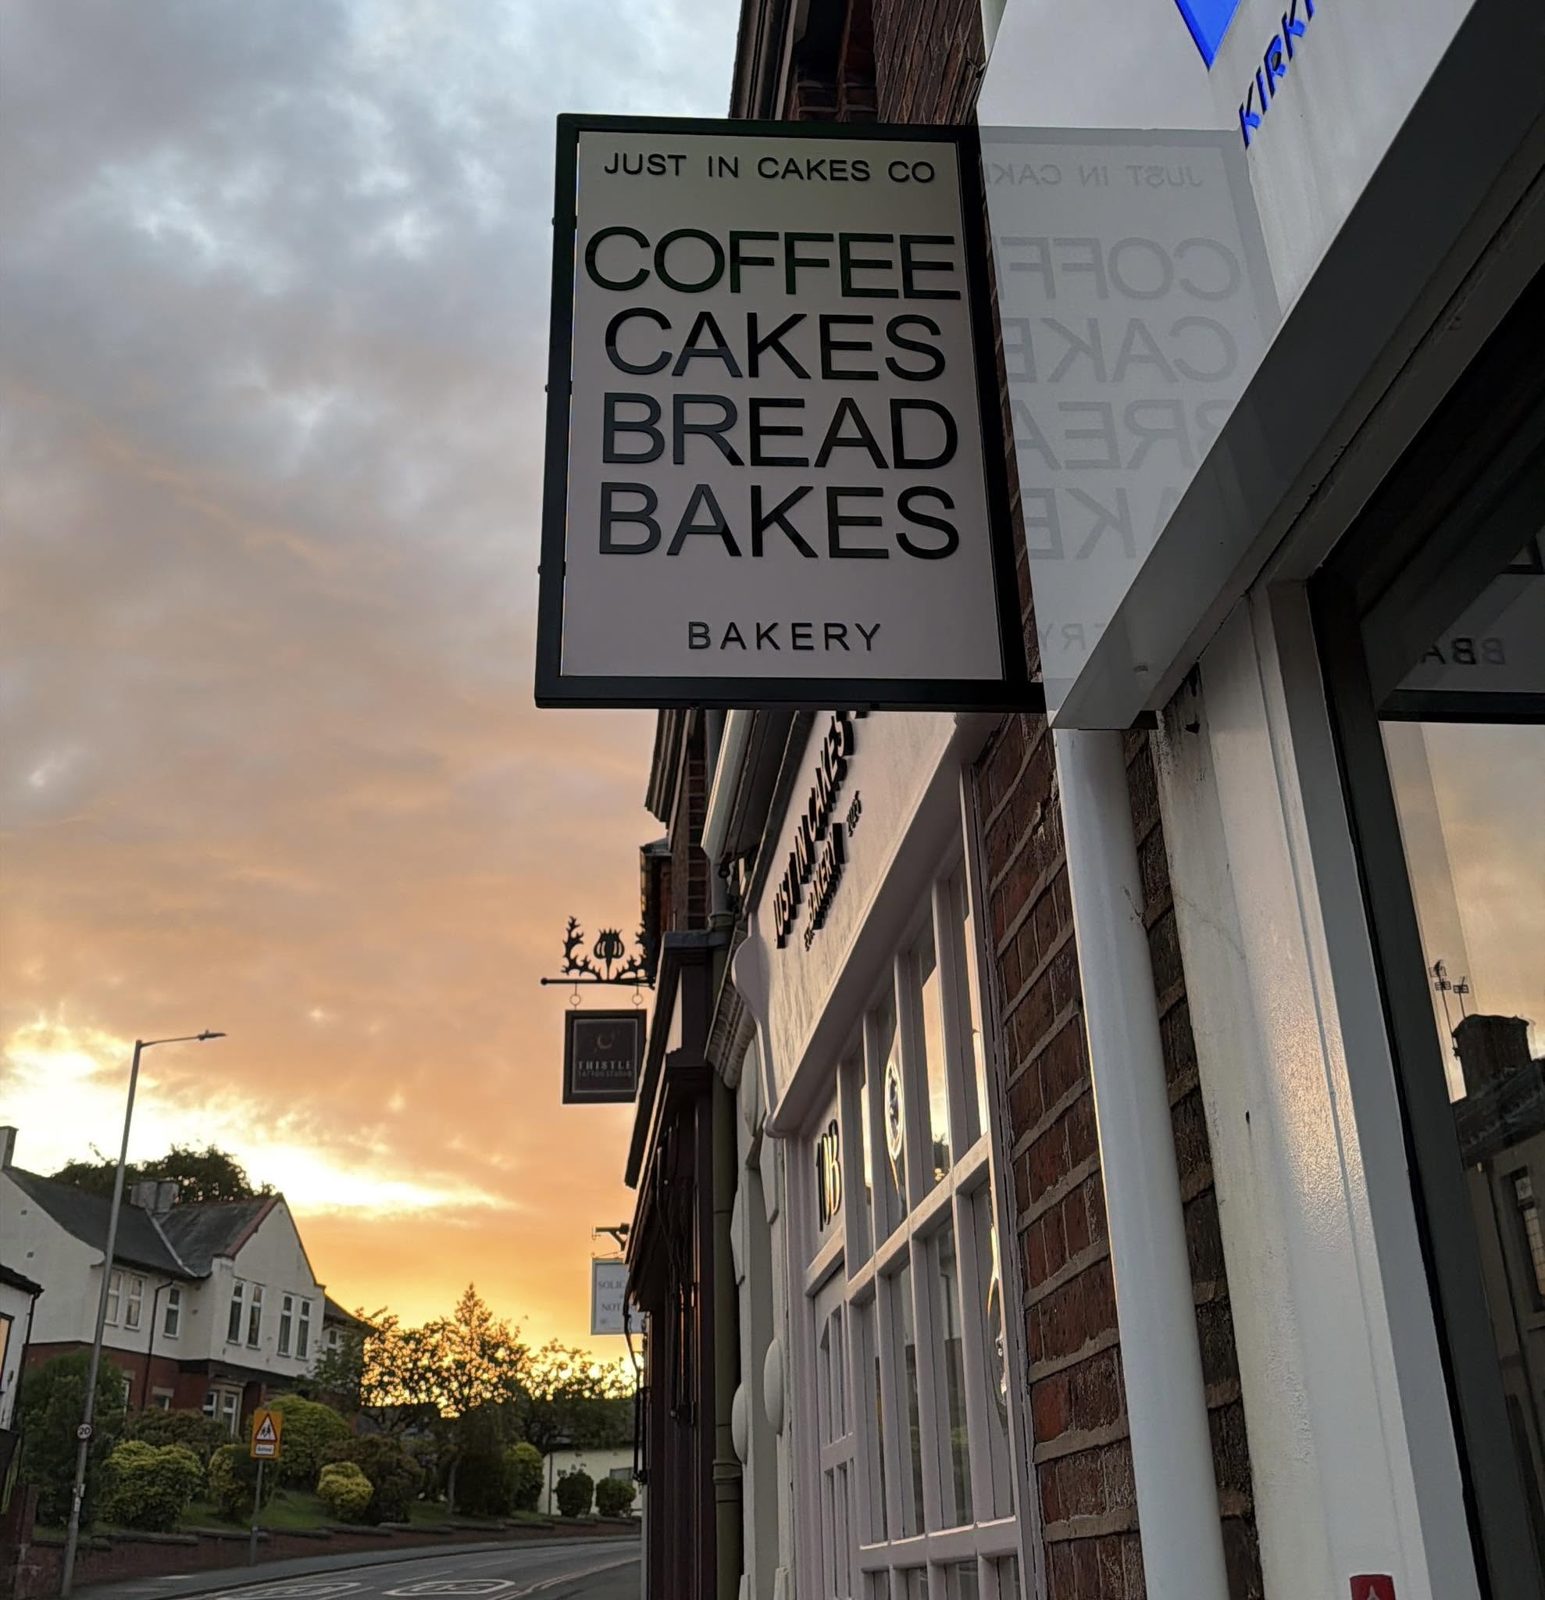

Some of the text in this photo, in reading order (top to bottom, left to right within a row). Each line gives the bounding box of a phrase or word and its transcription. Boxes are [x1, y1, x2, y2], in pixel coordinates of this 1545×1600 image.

[604, 152, 936, 183] JUST IN CAKES CO
[584, 226, 961, 300] COFFEE
[604, 307, 946, 381] CAKES
[602, 392, 959, 470] BREAD
[599, 481, 960, 560] BAKES
[688, 621, 882, 652] BAKERY
